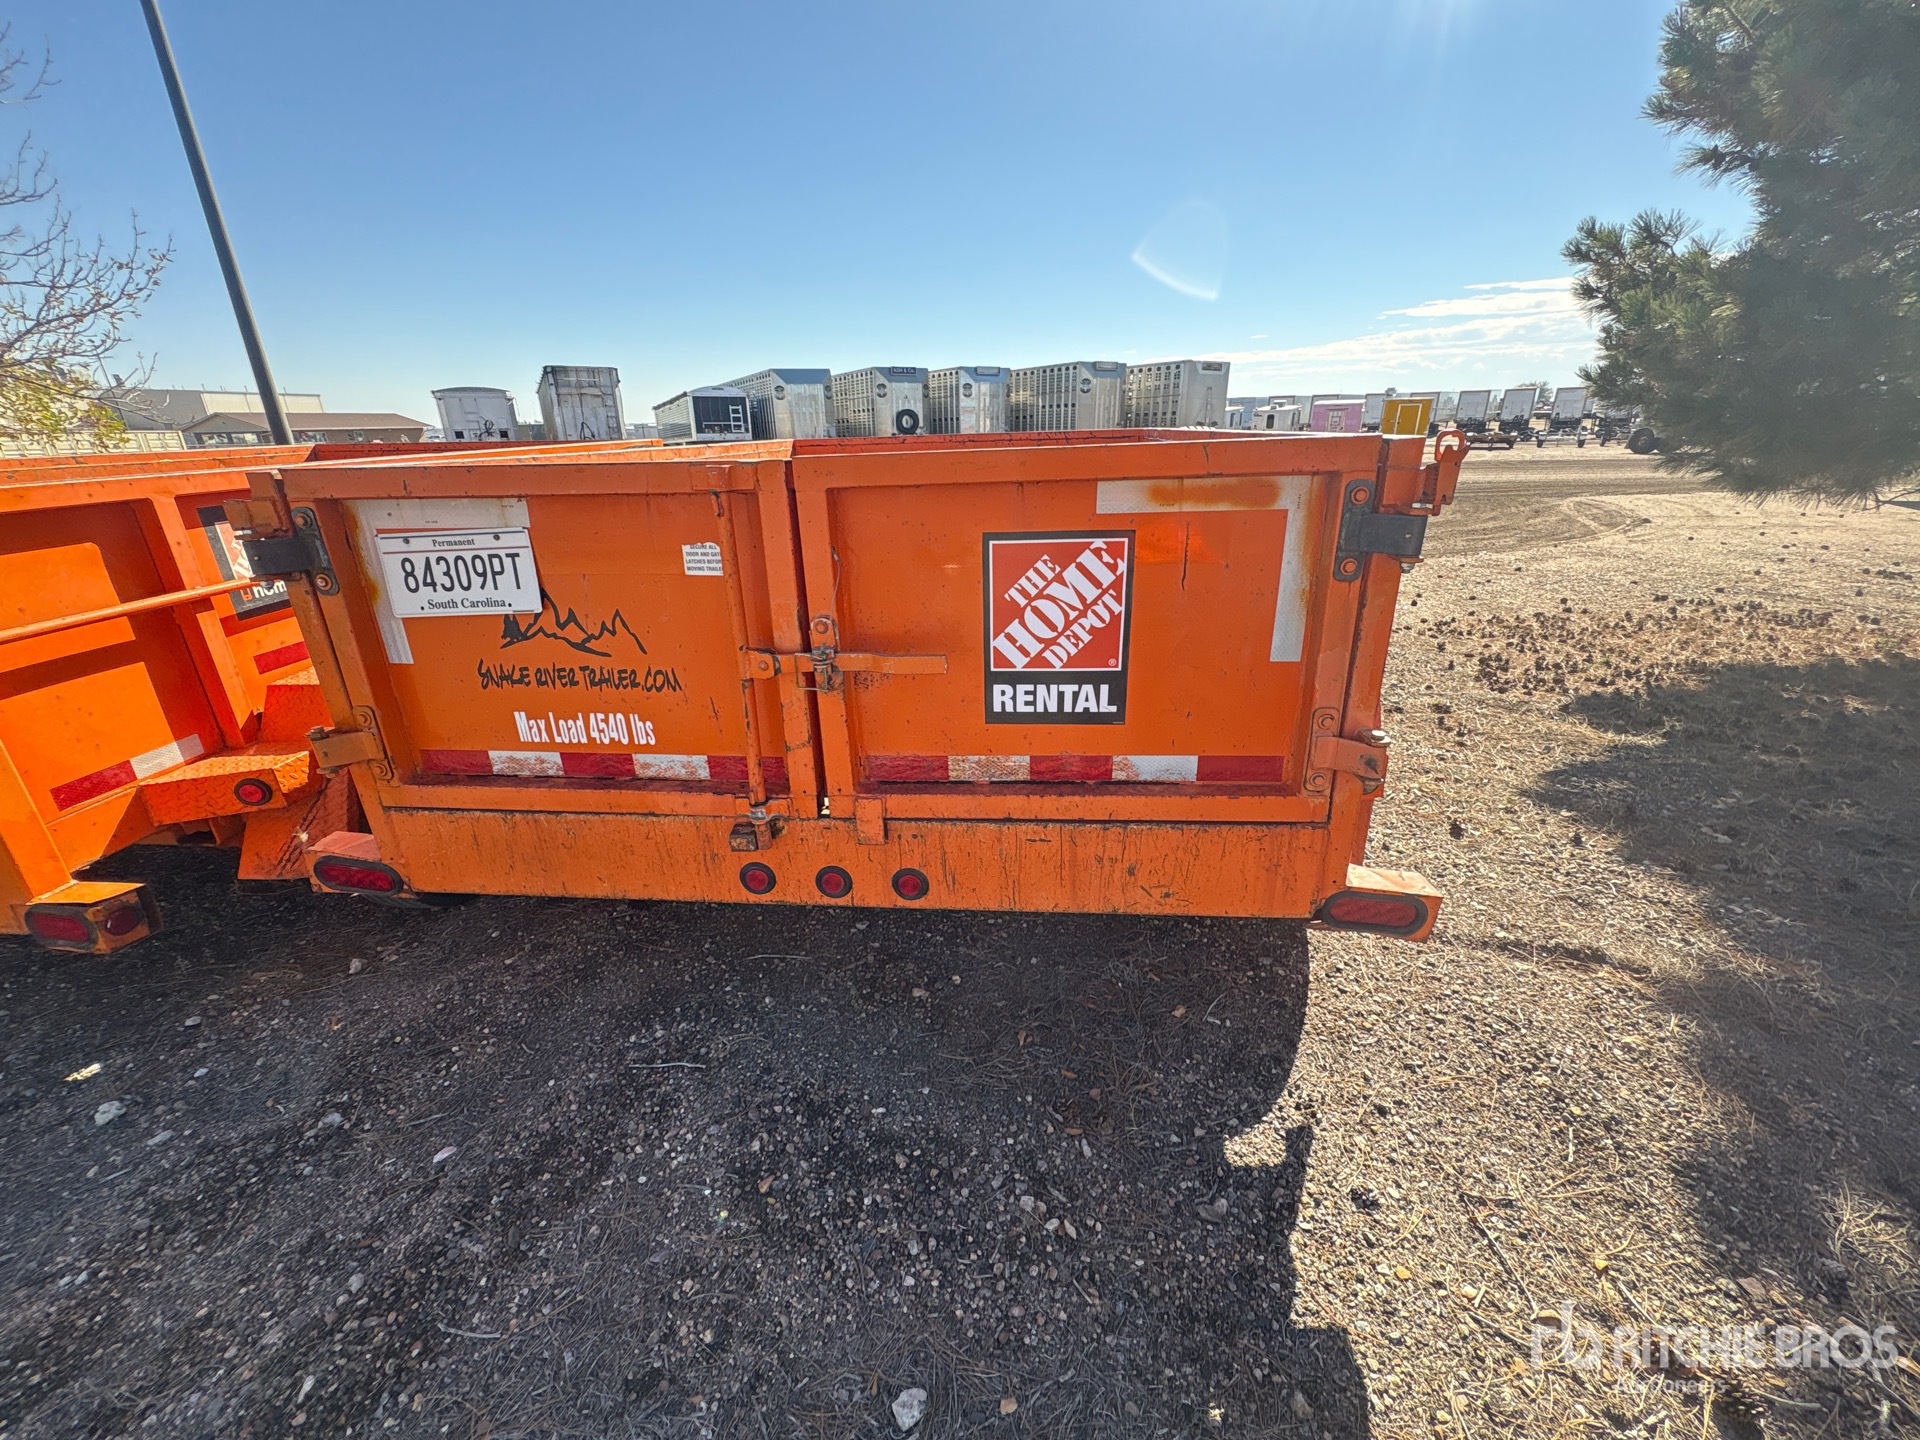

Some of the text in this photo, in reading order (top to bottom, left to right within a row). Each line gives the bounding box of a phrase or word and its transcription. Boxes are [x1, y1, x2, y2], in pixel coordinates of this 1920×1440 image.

[432, 538, 475, 547] Permanent
[401, 552, 521, 593] 84309PT
[1004, 554, 1061, 608] THE
[427, 597, 506, 610] South Carolina
[992, 540, 1125, 669] HOME
[1042, 589, 1123, 669] DEPOT
[992, 684, 1117, 713] RENTAL
[513, 711, 656, 746] Max Load 4540 lbs
